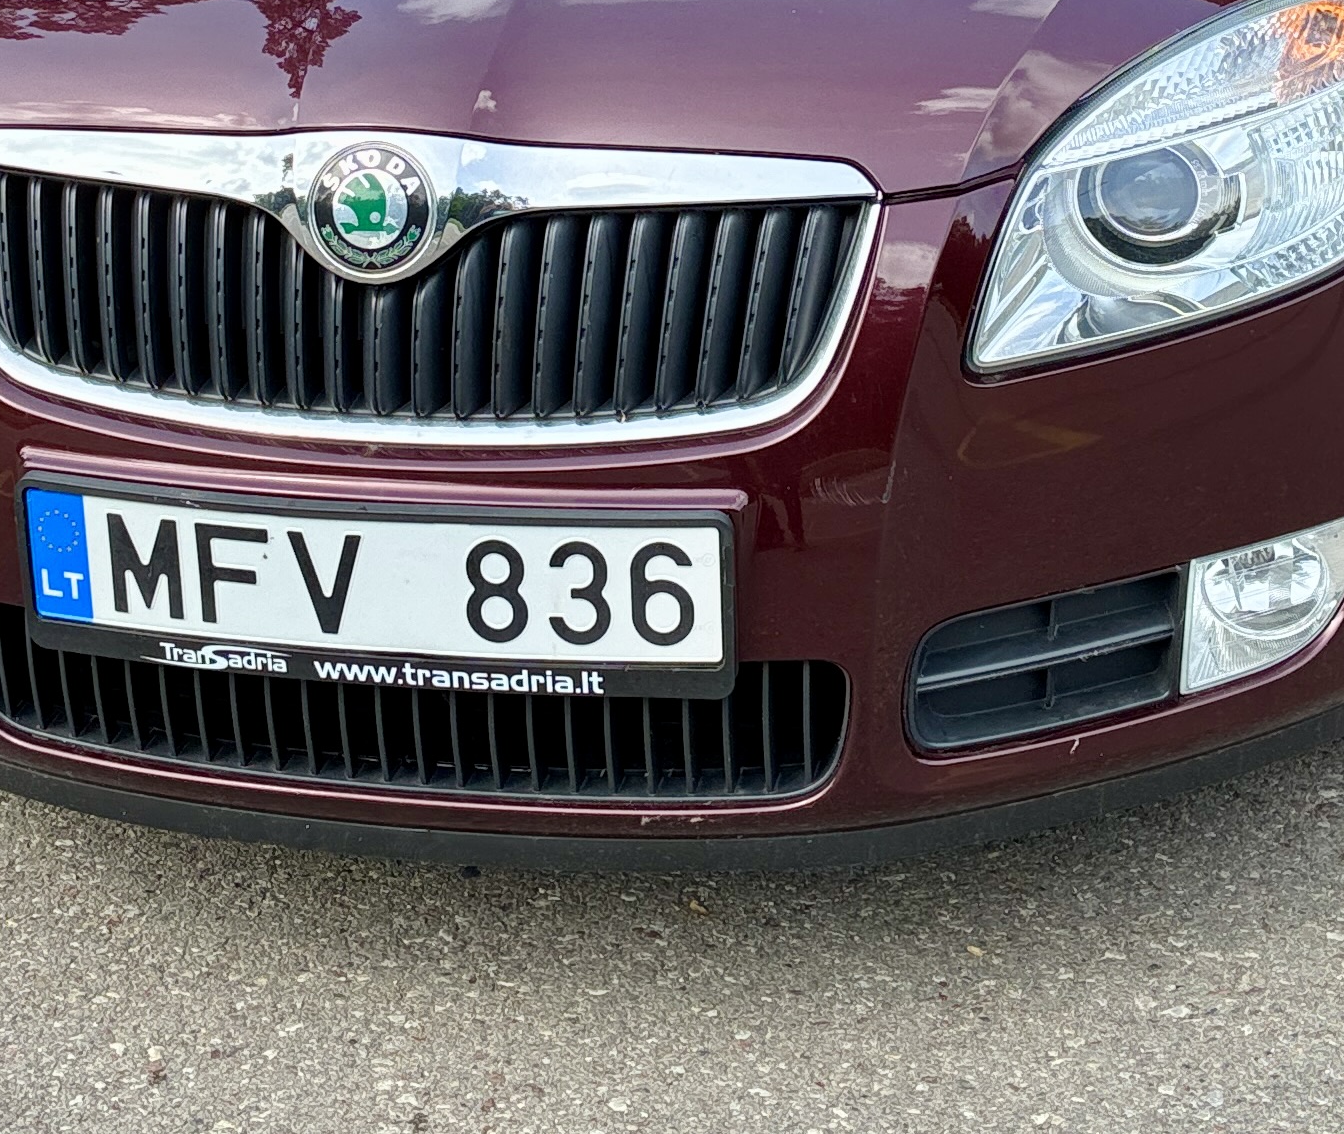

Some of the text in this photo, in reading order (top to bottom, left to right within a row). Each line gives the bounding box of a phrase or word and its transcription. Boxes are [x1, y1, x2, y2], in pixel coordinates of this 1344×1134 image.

[40, 568, 84, 599] LT
[106, 512, 696, 647] MFV 836
[312, 661, 605, 695] www.transadria.lt
